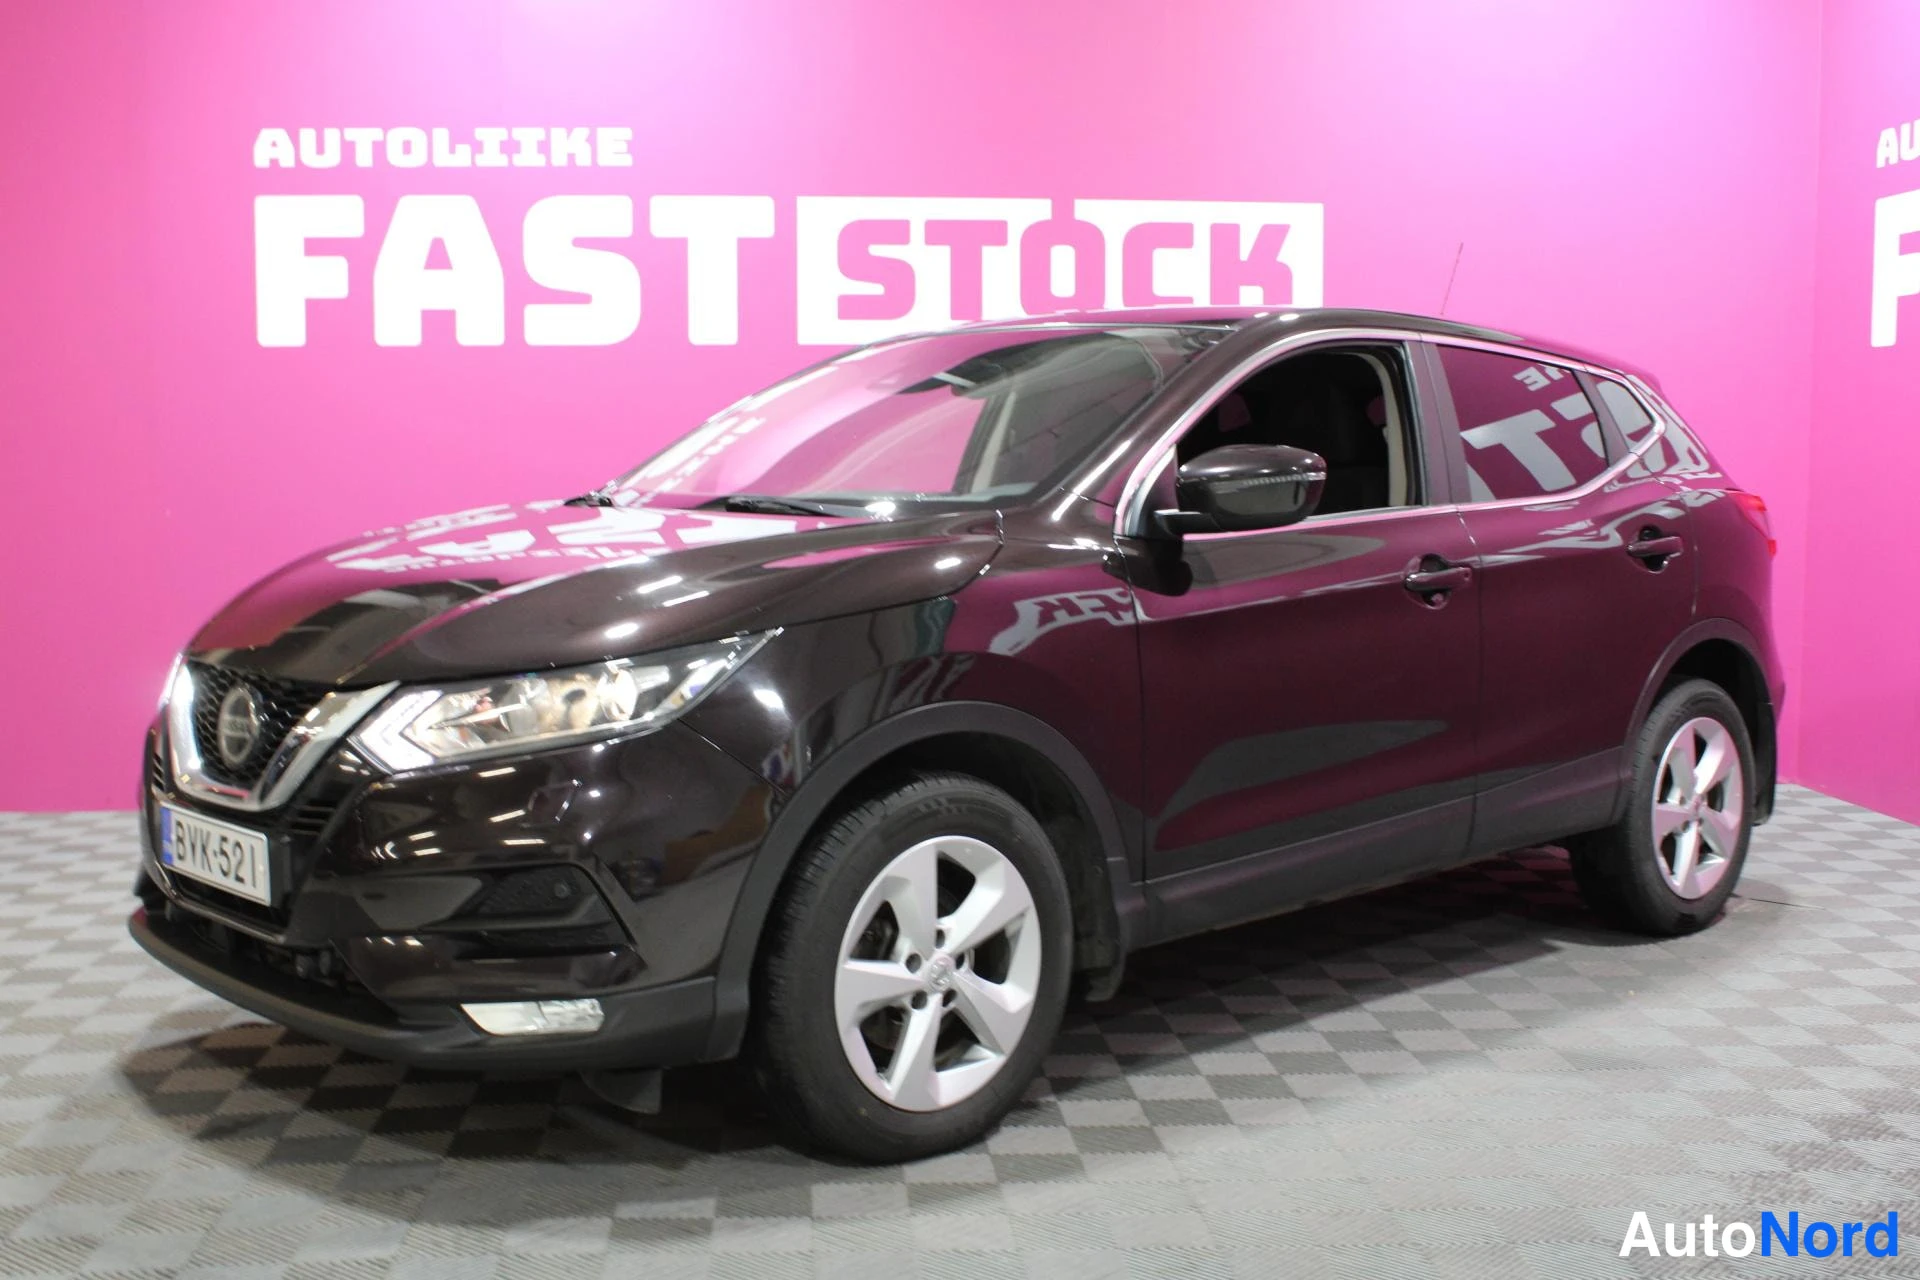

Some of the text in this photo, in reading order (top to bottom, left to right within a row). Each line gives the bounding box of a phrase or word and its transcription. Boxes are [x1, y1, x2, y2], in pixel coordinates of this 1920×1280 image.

[253, 127, 633, 168] AUTOLIIKE
[254, 194, 1294, 347] FAST STOCK
